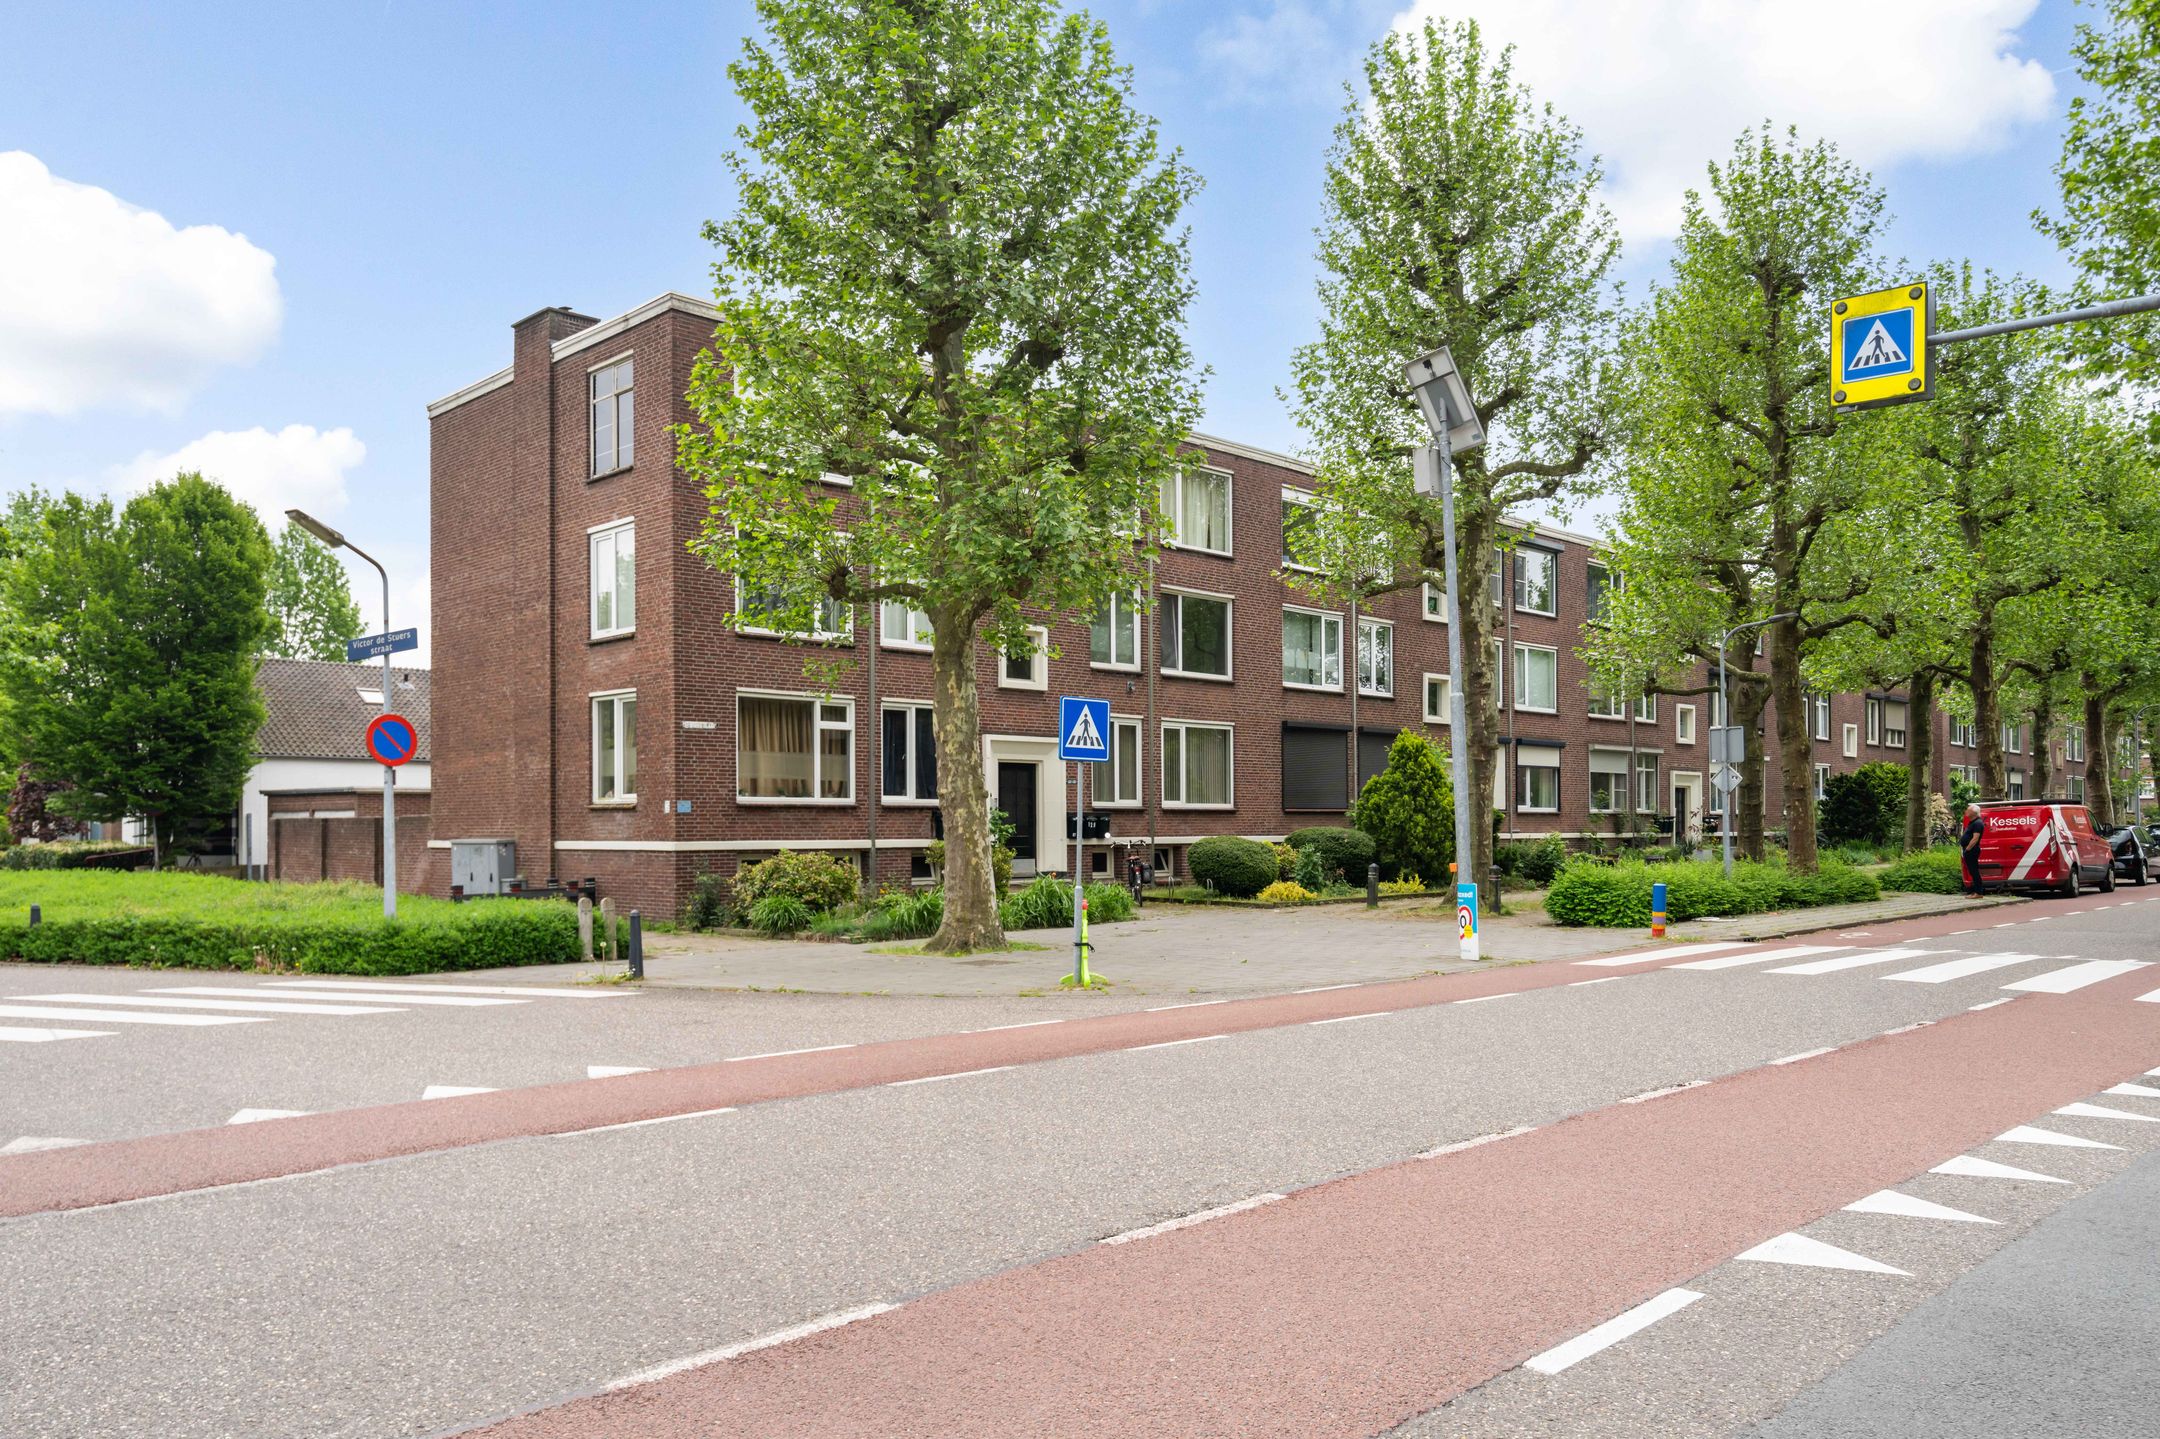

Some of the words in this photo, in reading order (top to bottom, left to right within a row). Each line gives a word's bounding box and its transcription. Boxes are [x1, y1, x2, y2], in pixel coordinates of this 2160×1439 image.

[352, 639, 373, 649] Victor
[387, 631, 411, 642] Stuers
[370, 644, 393, 655] straat
[1990, 815, 2037, 827] Kessels
